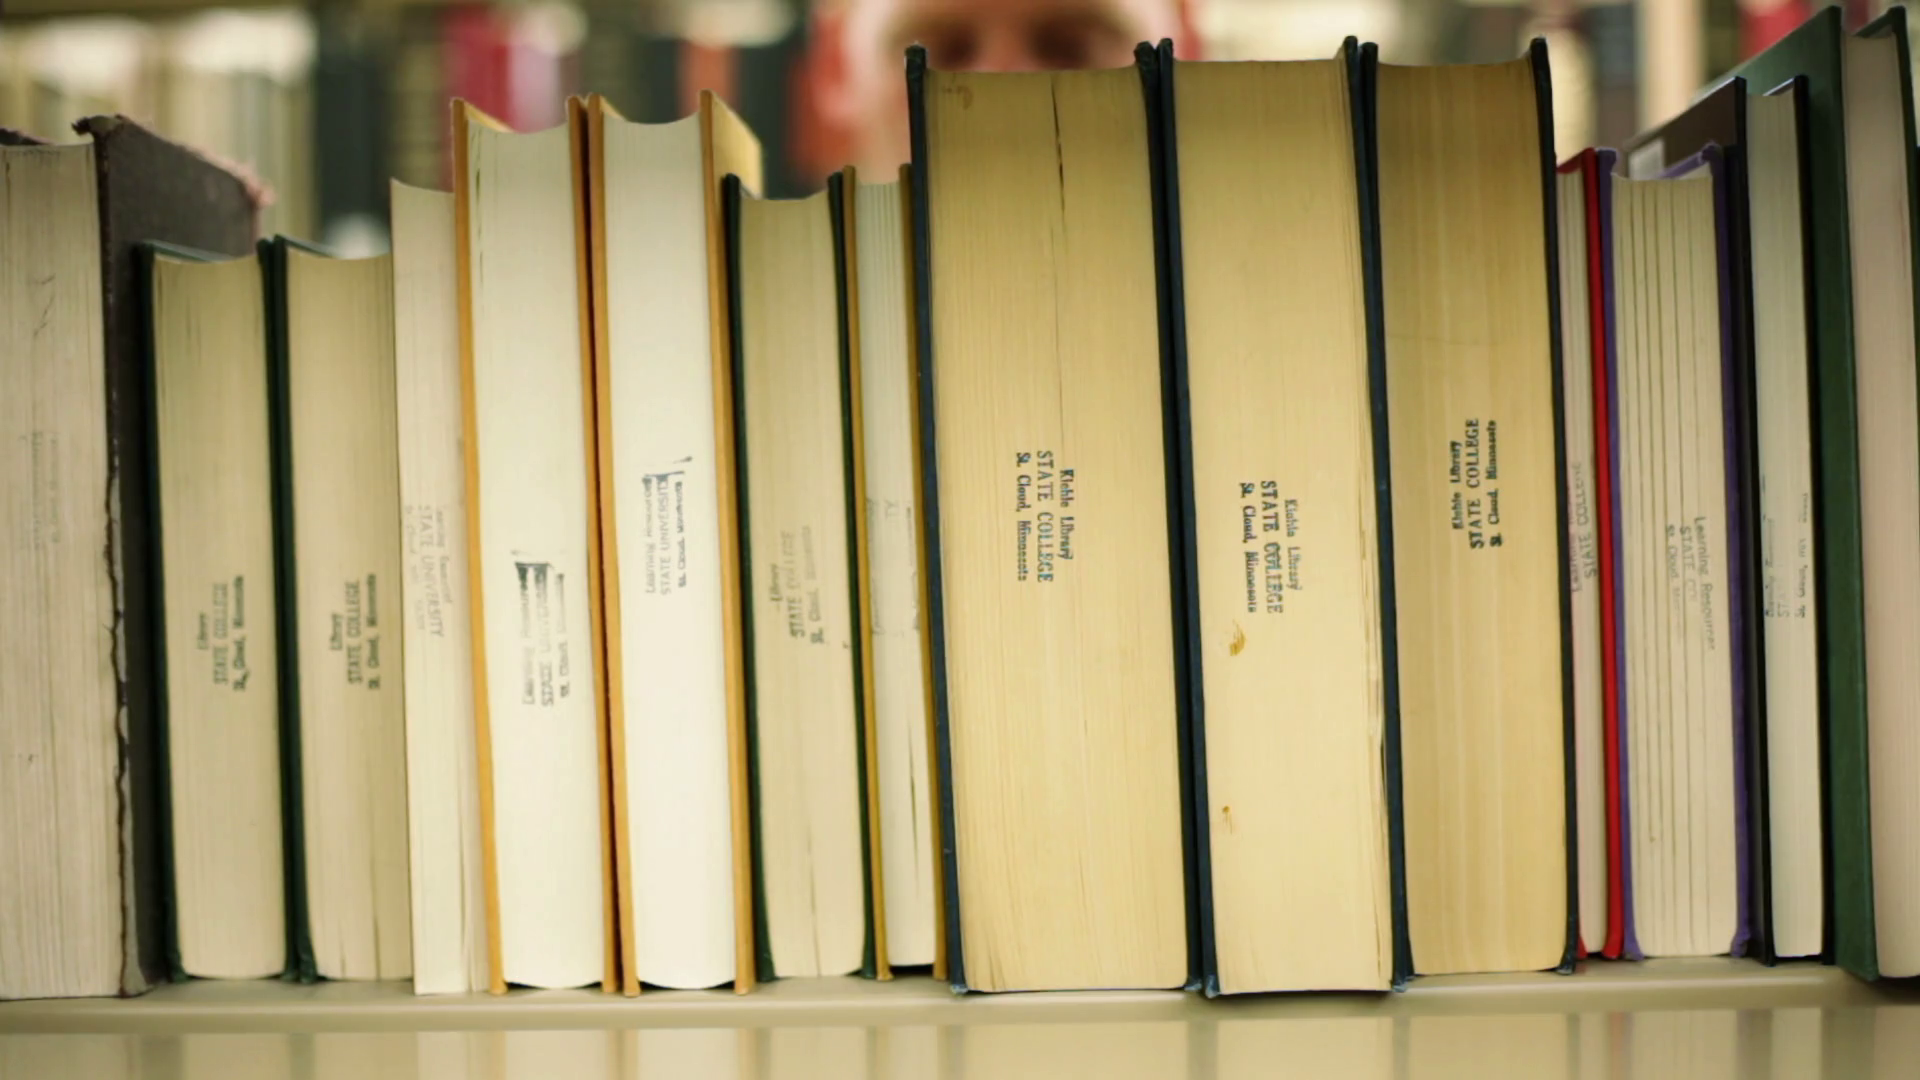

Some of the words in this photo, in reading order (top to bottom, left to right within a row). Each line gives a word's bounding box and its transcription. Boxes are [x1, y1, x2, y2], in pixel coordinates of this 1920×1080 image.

[1016, 452, 1031, 467] St.
[1450, 441, 1462, 483] Library
[1466, 419, 1480, 488] COLLEGE
[1485, 420, 1497, 480] Minnesota
[1016, 475, 1032, 512] Cloud,
[1037, 450, 1054, 501] STATE
[1240, 483, 1255, 498] St.
[656, 474, 671, 551] UNIVERSIT
[1242, 505, 1258, 543] Cloud,
[1261, 480, 1280, 532] STATE
[1467, 499, 1484, 549] STATE
[1017, 520, 1031, 581] Minnesota
[1037, 512, 1054, 582] COLLEGE
[1058, 516, 1074, 560] Library
[1578, 531, 1597, 579] STATE
[1680, 526, 1696, 570] STATE
[1694, 516, 1711, 575] Learning
[659, 556, 671, 595] STATE
[1245, 551, 1259, 612] Minnesota
[1264, 541, 1284, 613] COLLEGE
[1286, 546, 1303, 590] Library
[345, 580, 361, 638] COLLEGE
[421, 555, 445, 637] UNIVERSITY
[786, 596, 805, 638] STATE
[346, 645, 363, 684] STATE
